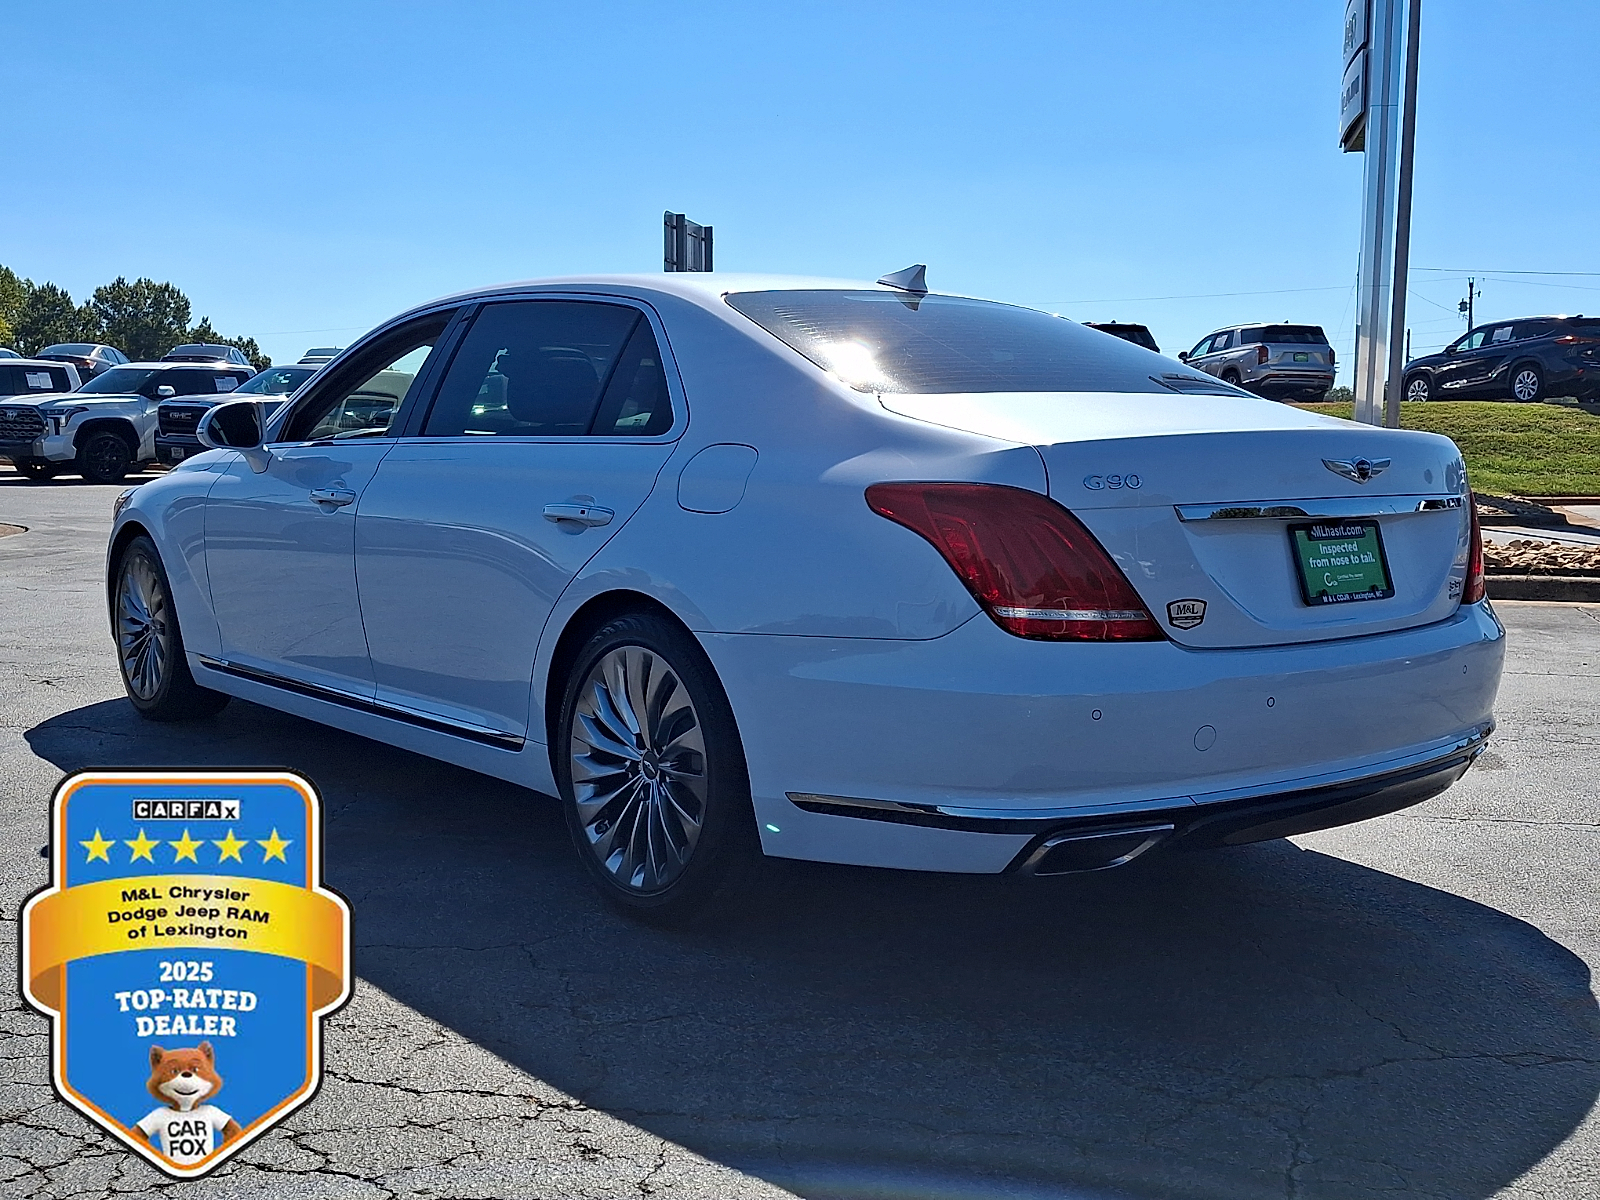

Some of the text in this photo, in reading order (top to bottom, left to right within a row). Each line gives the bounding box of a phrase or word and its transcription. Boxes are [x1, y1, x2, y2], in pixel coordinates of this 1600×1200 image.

[1082, 473, 1143, 491] G90
[1319, 541, 1358, 556] Inspected
[1309, 551, 1376, 568] from nose to tail.
[1176, 603, 1199, 616] M&L
